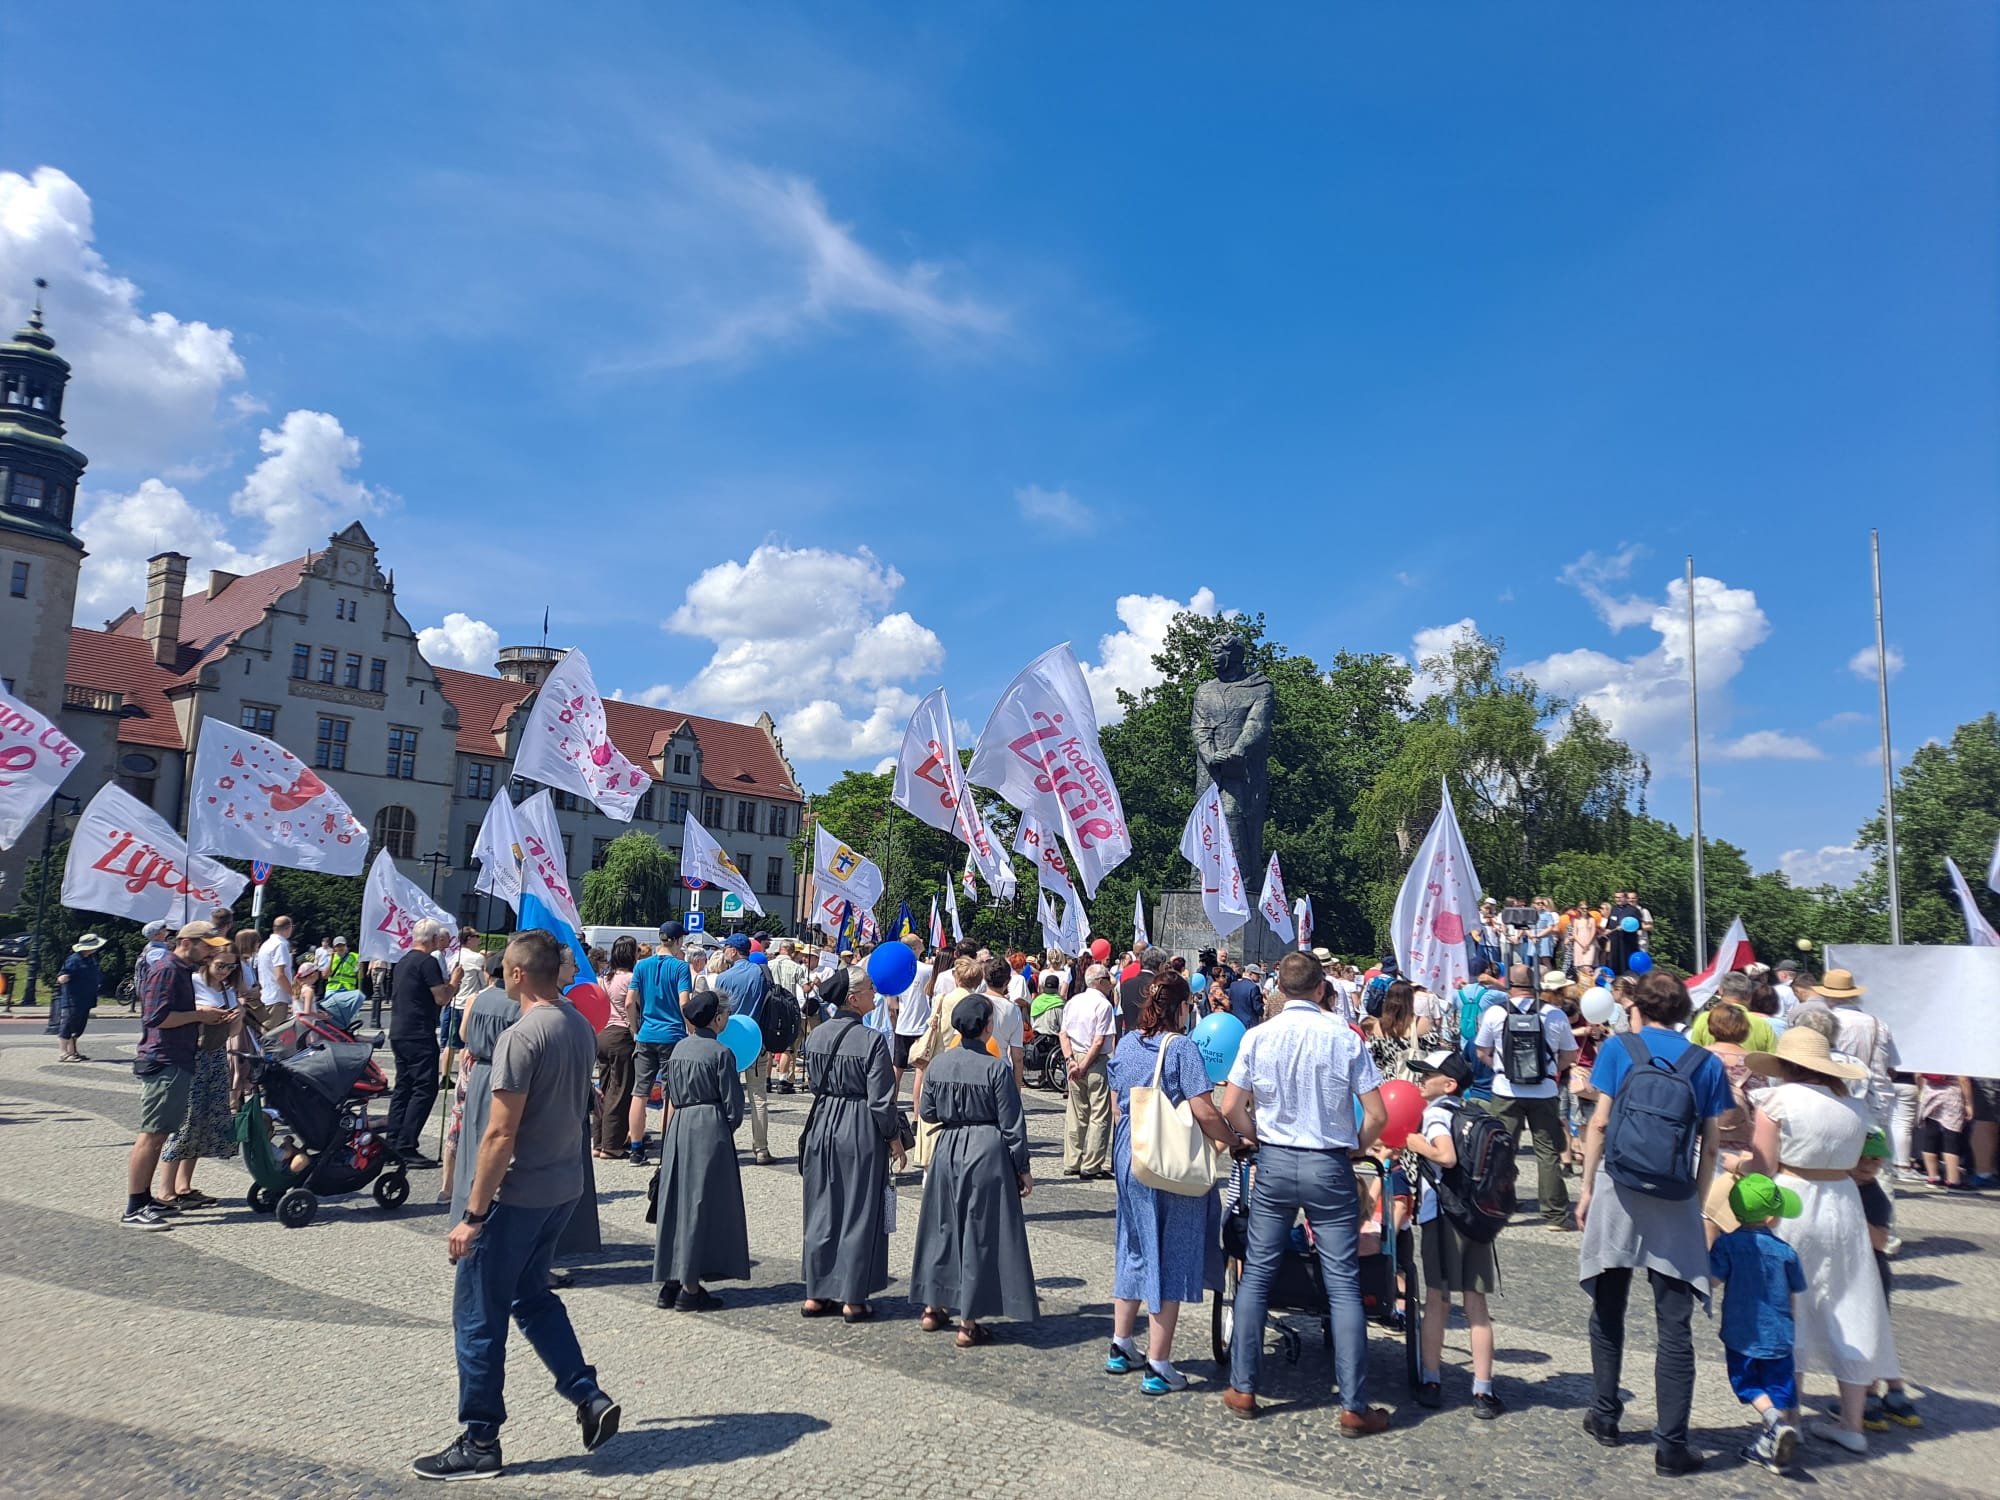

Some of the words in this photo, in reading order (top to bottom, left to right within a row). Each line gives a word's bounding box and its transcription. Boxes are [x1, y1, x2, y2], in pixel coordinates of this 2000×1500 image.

[1007, 711, 1113, 850] Życie
[1057, 736, 1115, 813] Kocham
[688, 914, 700, 931] P
